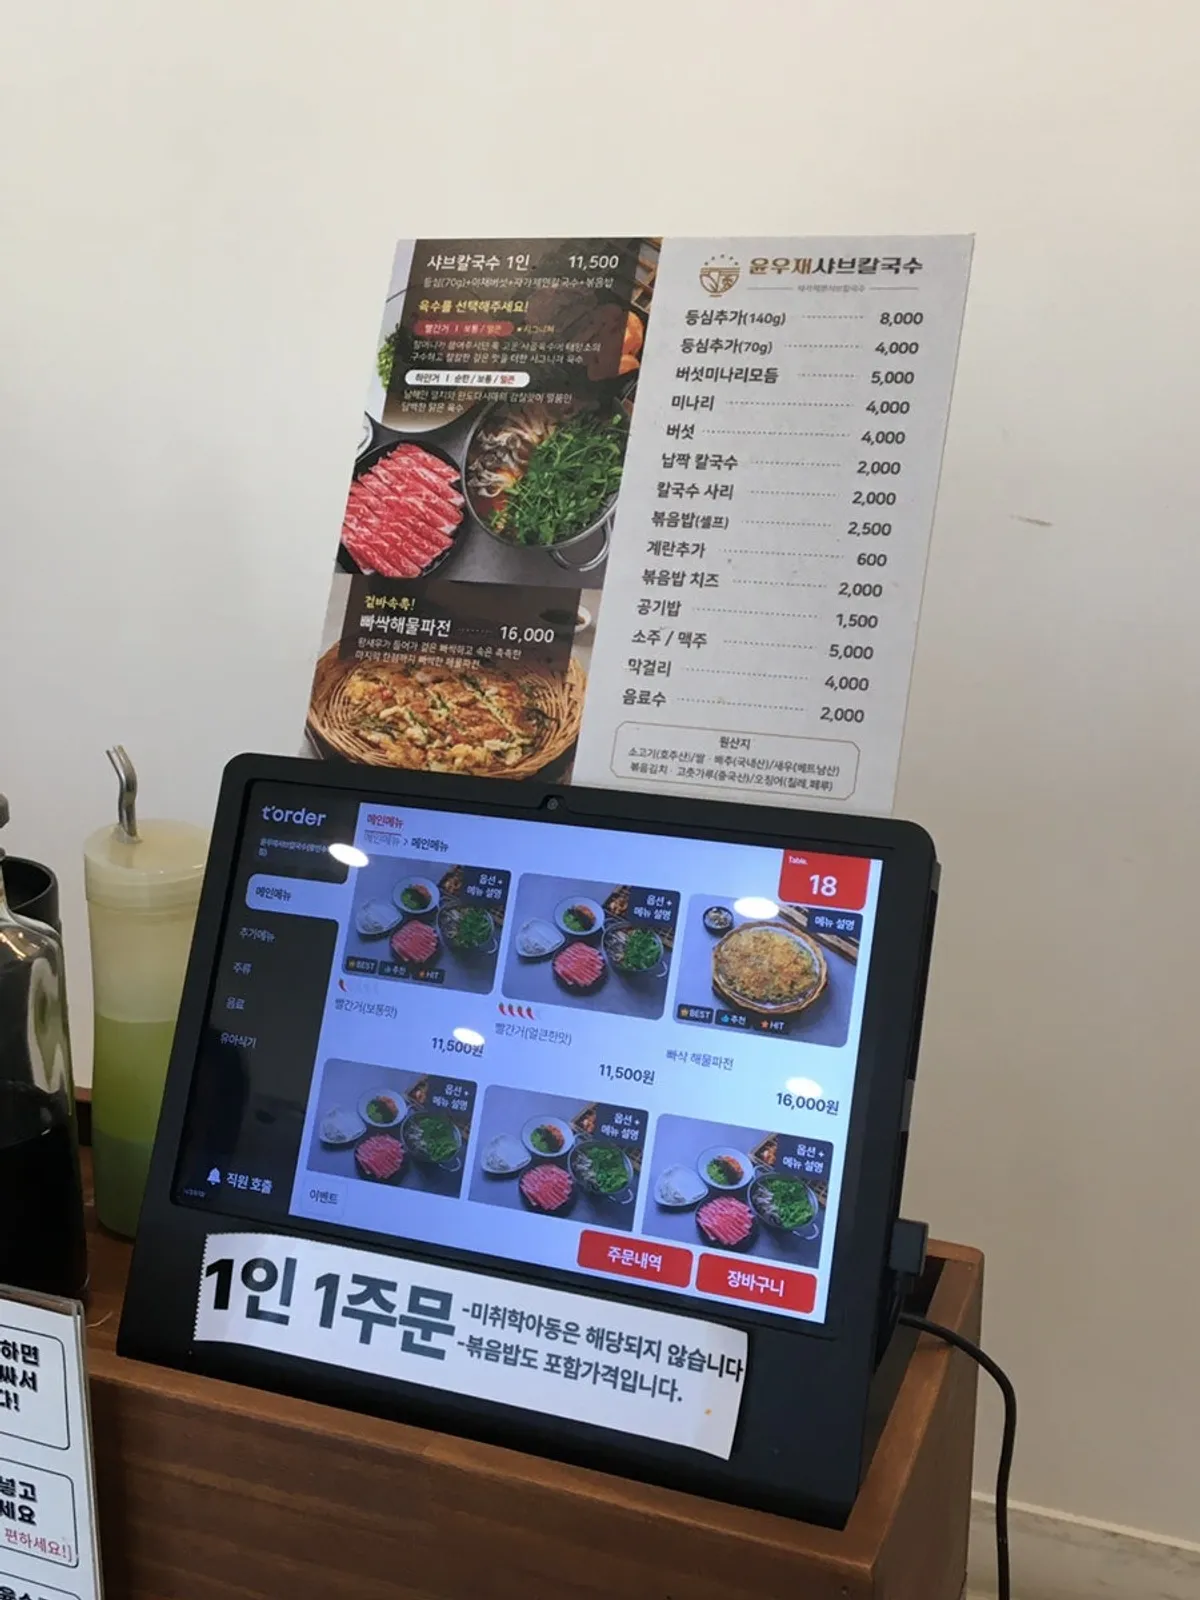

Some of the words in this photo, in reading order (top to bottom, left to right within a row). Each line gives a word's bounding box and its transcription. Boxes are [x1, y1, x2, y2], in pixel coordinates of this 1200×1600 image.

[427, 254, 501, 271] 샤브칼국수
[507, 254, 530, 271] 1인
[569, 255, 619, 271] 11,500
[749, 256, 924, 276] 윤우재샤브칼국수
[456, 300, 529, 313] 선택해주세요!
[685, 309, 786, 327] 등심추가(140g)
[880, 312, 924, 327] 8,000
[680, 338, 773, 356] 등심추가(70g)
[875, 341, 919, 356] 4,000
[675, 366, 779, 385] 버섯미나리모듬
[871, 370, 915, 386] 5,000
[671, 394, 715, 412] 미나리
[866, 400, 910, 416] 4,000
[666, 423, 695, 440] 버섯
[861, 430, 906, 446] 4,000
[695, 454, 739, 472] 칼국수
[857, 461, 901, 476] 2,000
[656, 482, 700, 499] 칼국수
[704, 483, 735, 500] 사리
[852, 491, 897, 506] 2,000
[651, 511, 729, 530] 볶음밥(셀프)
[847, 521, 892, 537] 2,500
[646, 540, 706, 559] 계란추가
[857, 553, 888, 567] 600
[641, 568, 686, 588] 볶음밥
[689, 571, 720, 589] 치즈
[838, 582, 883, 598] 2,000
[637, 599, 682, 617] 공기밥
[835, 613, 879, 629] 1,500
[360, 614, 452, 638] 빠싹해물파전
[500, 625, 555, 644] 16,000
[631, 629, 661, 647] 소주
[677, 631, 707, 649] 맥주
[829, 644, 874, 660] 5,000
[627, 658, 672, 677] 막걸리
[824, 676, 869, 692] 4,000
[622, 688, 667, 707] 음료수
[820, 707, 864, 723] 2,000
[719, 736, 751, 750] 원산지
[367, 813, 405, 829] 메인메뉴
[411, 837, 449, 853] 메인메뉴
[255, 886, 292, 902] 메인메뉴
[809, 874, 838, 897] 18
[814, 915, 833, 929] 메뉴
[836, 919, 855, 932] 설명
[689, 1008, 711, 1020] BEST
[731, 1014, 747, 1026] 추천
[769, 1020, 785, 1031] HIT
[690, 1052, 734, 1071] 해물파전
[599, 1063, 655, 1085] 11,500원
[776, 1092, 840, 1116] 16,000원
[804, 1158, 824, 1175] 설명
[226, 1172, 249, 1188] 직원
[250, 1175, 274, 1195] 호출
[308, 1190, 338, 1206] 이벤트
[607, 1246, 663, 1273] 주문내역
[727, 1269, 785, 1298] 장바구니
[205, 1257, 297, 1326] 1인
[314, 1272, 455, 1361] 1주문
[0, 1339, 40, 1368] 하면
[462, 1302, 581, 1345] -미취학아동은
[585, 1325, 662, 1364] 해당되지
[666, 1342, 744, 1383] 않습니다
[457, 1334, 538, 1371] -볶음밥도
[543, 1352, 683, 1403] 포함가격입니다.
[5, 1527, 72, 1563] 편하세요!)
